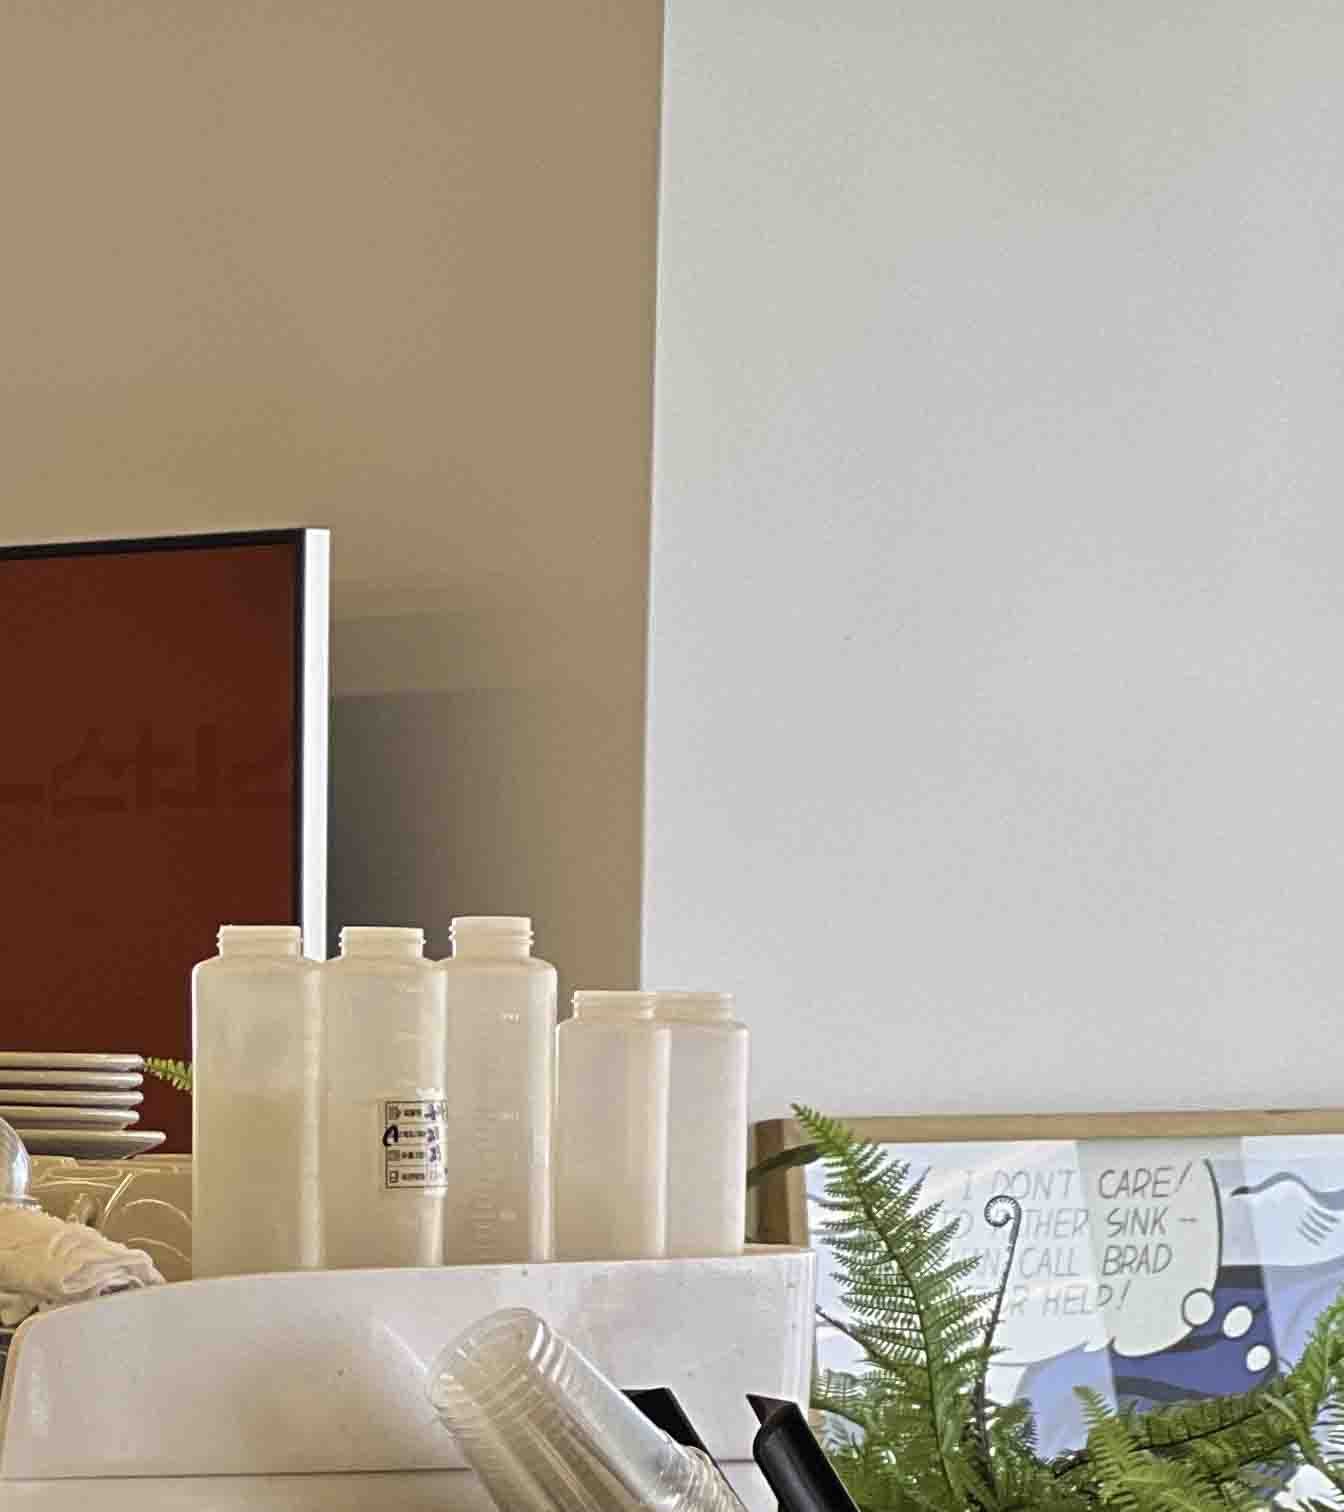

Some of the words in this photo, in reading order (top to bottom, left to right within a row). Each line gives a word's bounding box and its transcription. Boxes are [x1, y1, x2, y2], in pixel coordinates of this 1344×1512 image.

[1097, 1162, 1193, 1200] CARE!
[1106, 1206, 1169, 1239] SINK
[1018, 1246, 1082, 1279] CALL
[1101, 1243, 1173, 1277] BRAD
